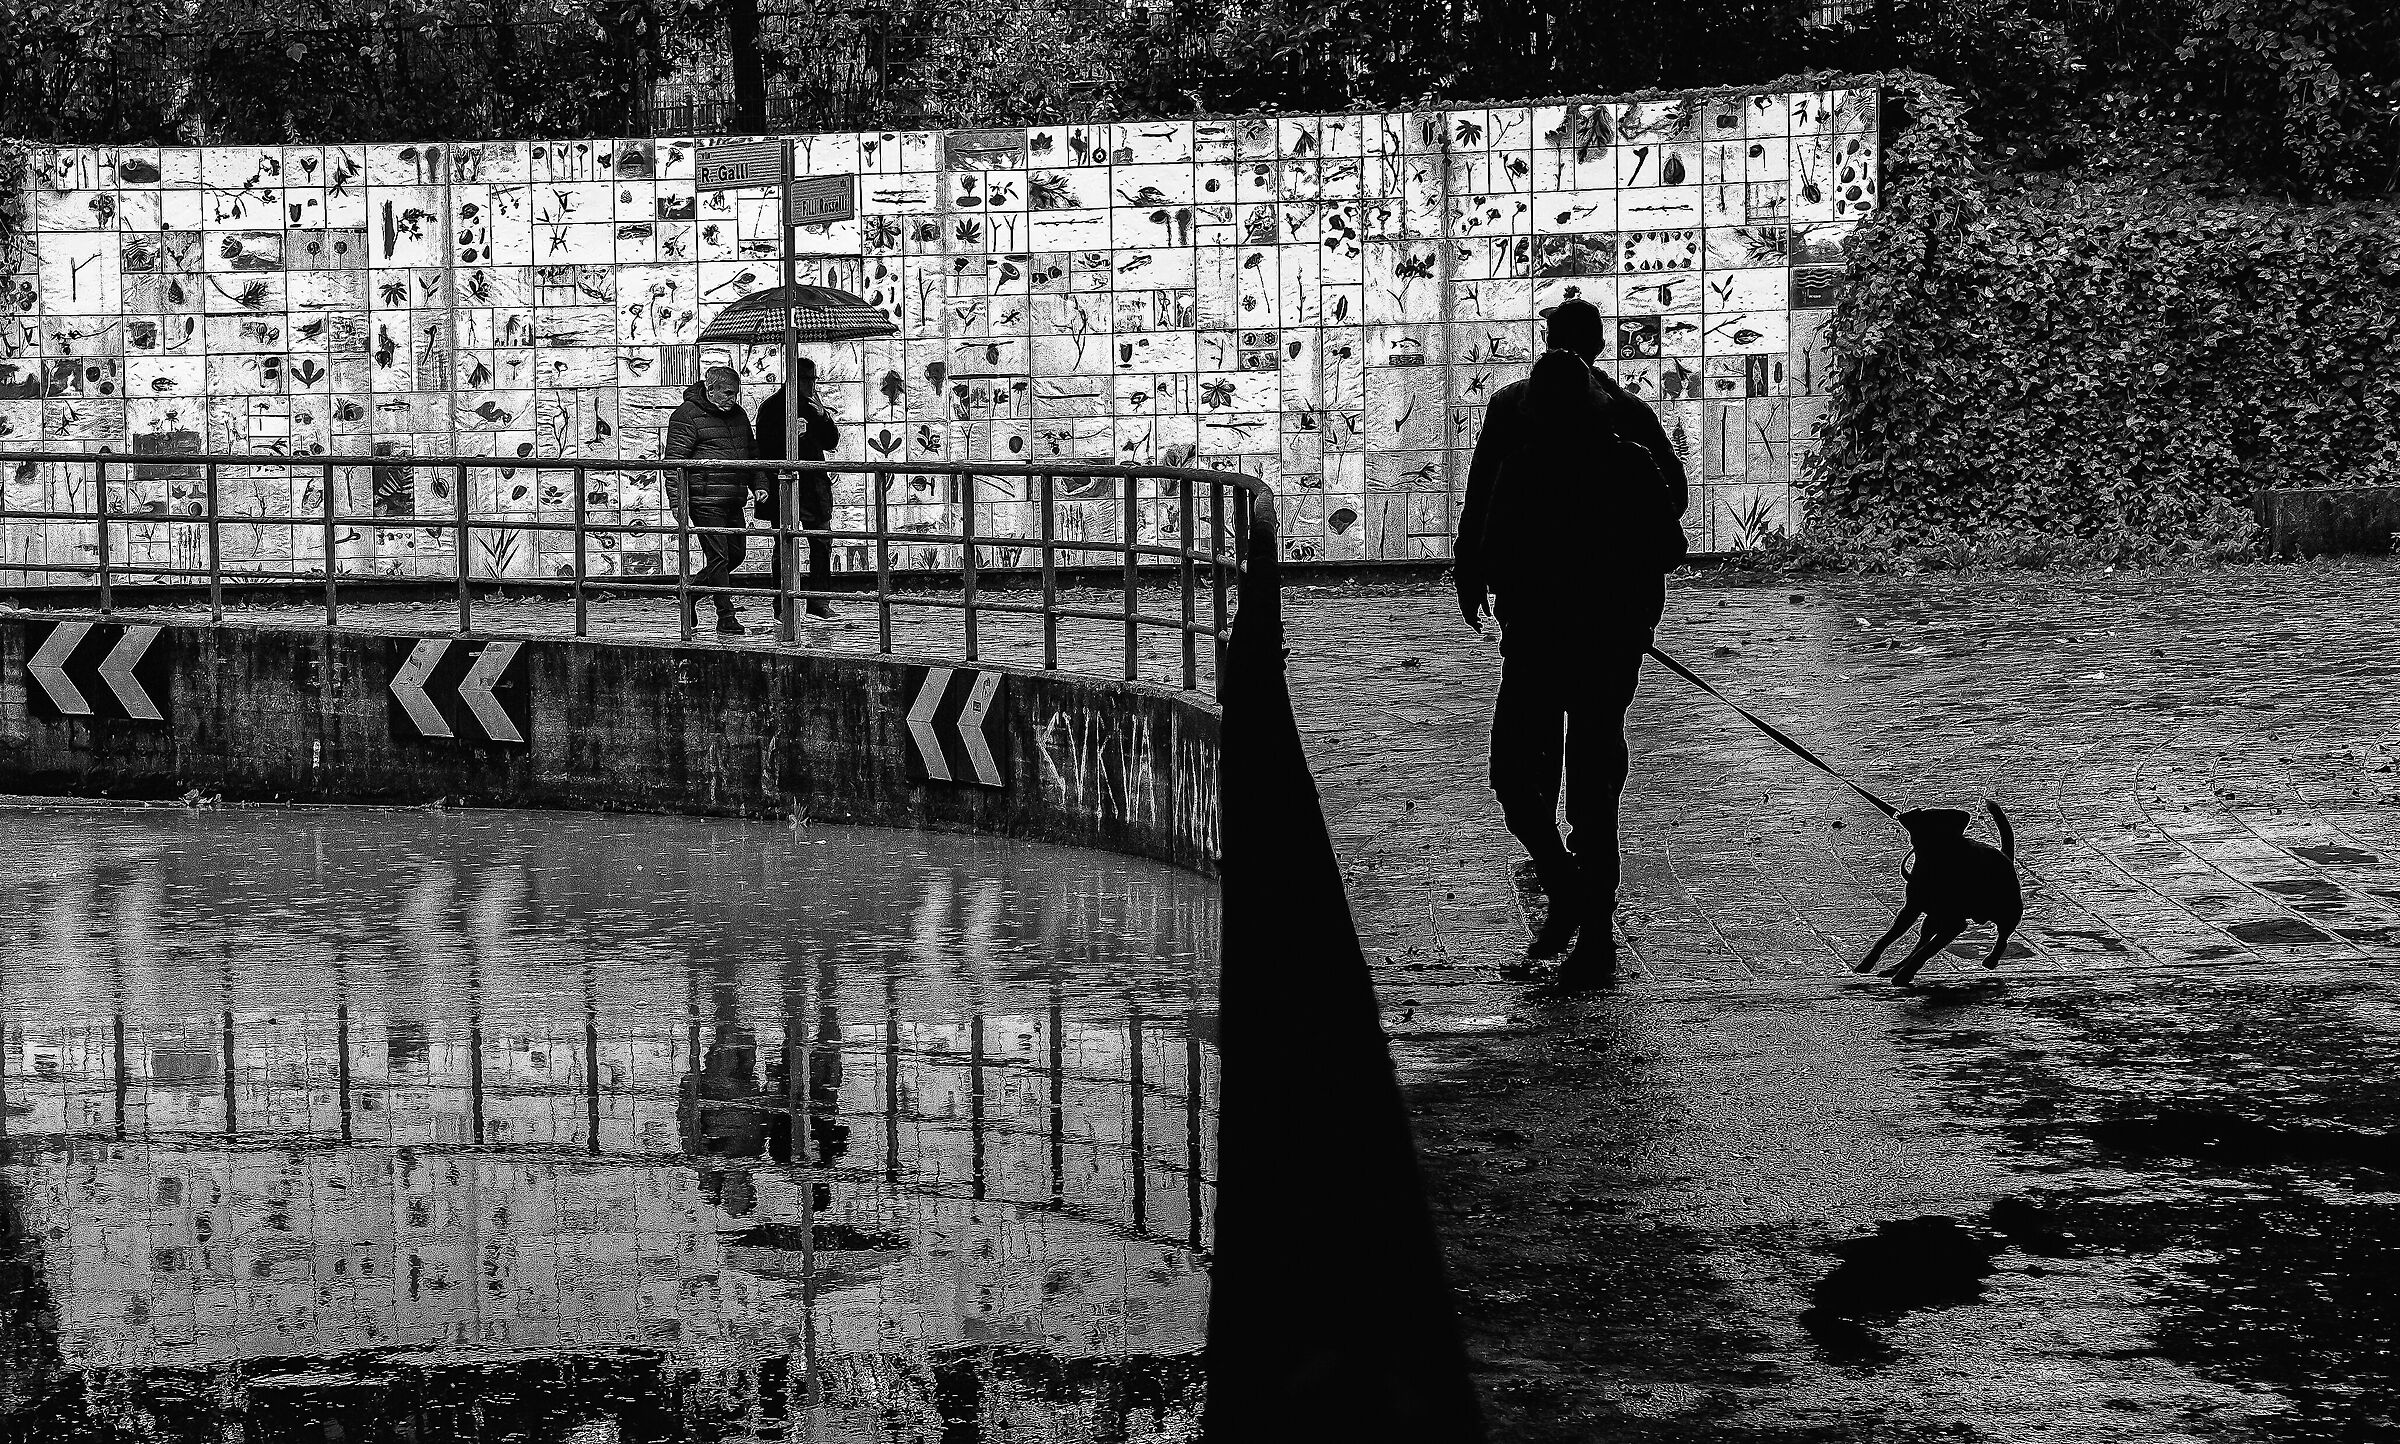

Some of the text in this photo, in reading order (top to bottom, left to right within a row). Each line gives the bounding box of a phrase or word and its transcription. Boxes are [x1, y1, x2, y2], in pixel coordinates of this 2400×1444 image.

[701, 163, 749, 183] R. Galli
[819, 195, 849, 214] Rosselli
